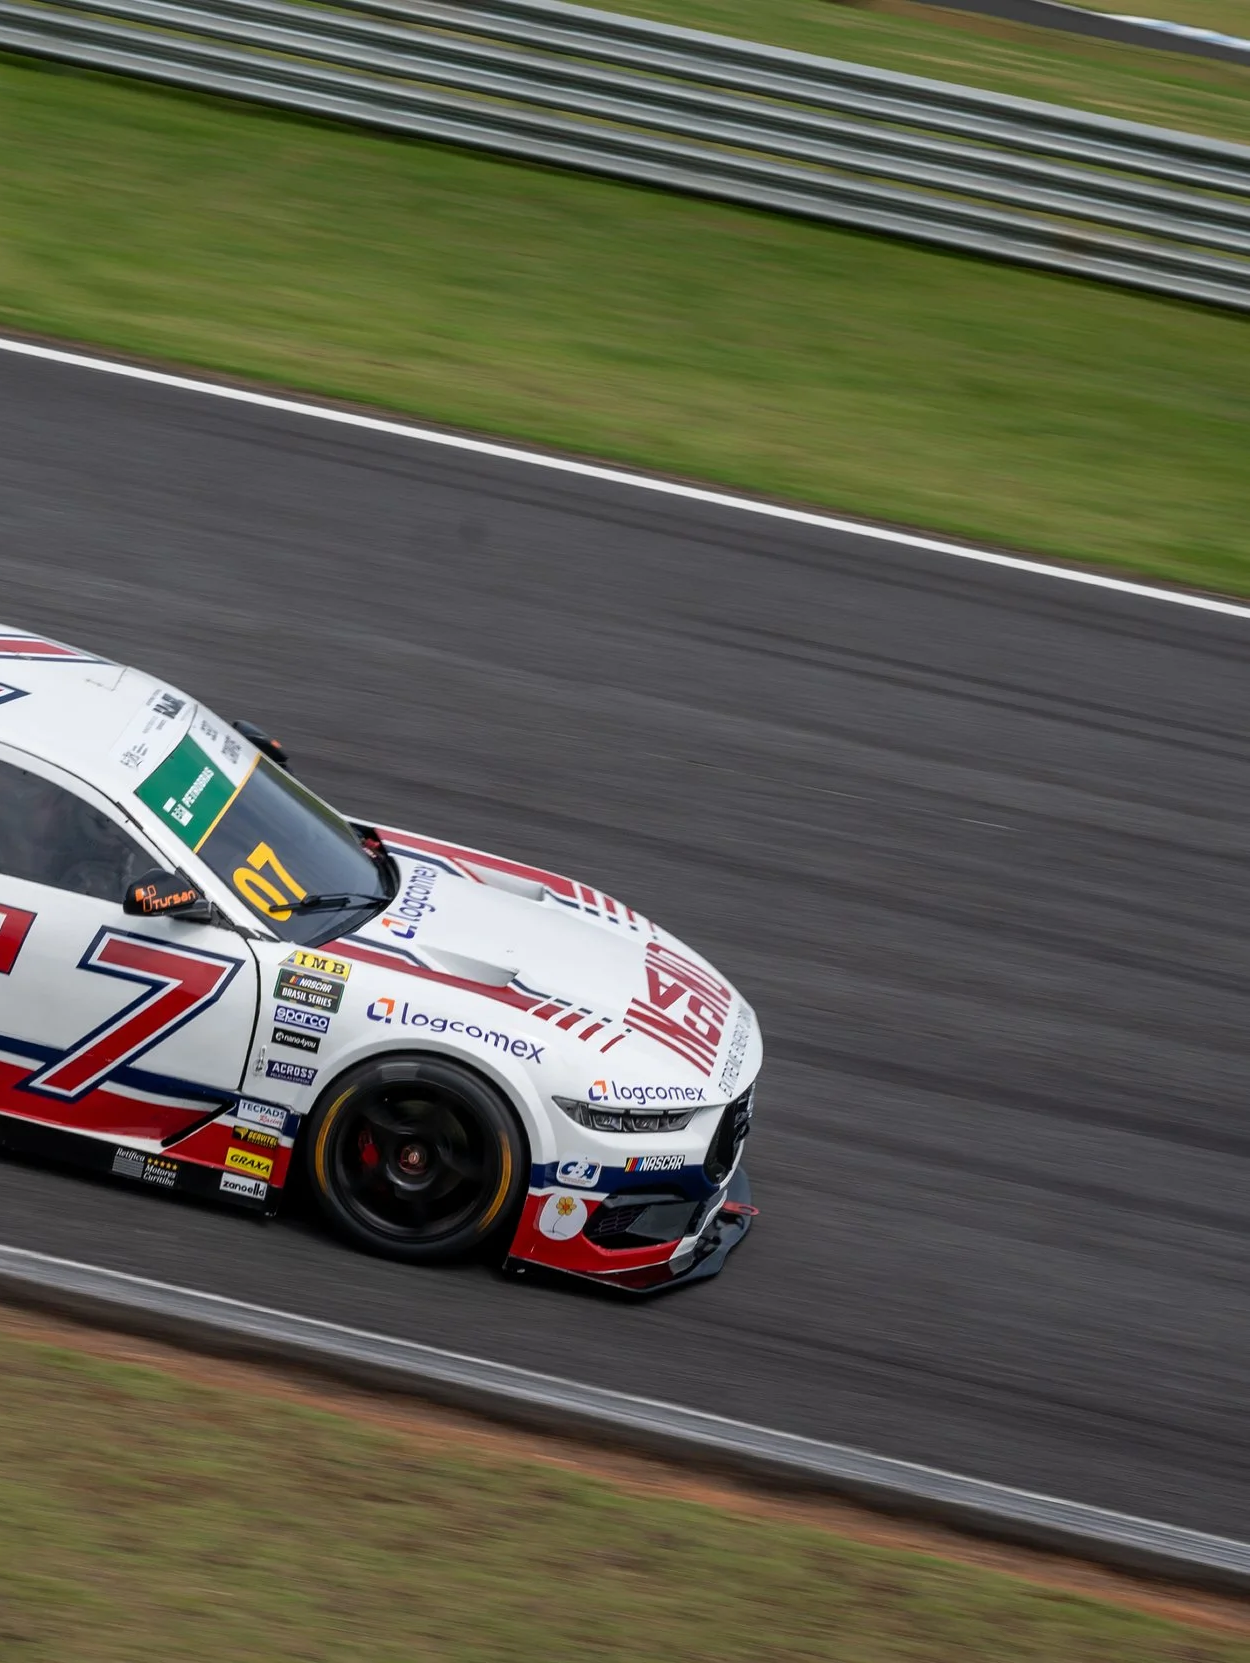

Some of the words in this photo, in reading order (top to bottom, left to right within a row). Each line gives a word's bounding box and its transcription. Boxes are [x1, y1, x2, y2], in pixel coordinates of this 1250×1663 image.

[233, 841, 308, 922] 07
[299, 977, 333, 994] NASCAR
[281, 986, 307, 1001] BRASIL
[307, 993, 333, 1008] SERIES
[76, 925, 247, 1104] 7
[276, 1006, 329, 1030] sparco
[284, 1034, 317, 1049] nano4you
[401, 1002, 546, 1065] logcomex
[271, 1062, 316, 1080] ACROSS
[611, 1080, 707, 1105] logcomex
[242, 1101, 285, 1120] TECPADS
[144, 1163, 177, 1180] Motores
[230, 1153, 270, 1174] GRAXA
[560, 1159, 598, 1181] CBA
[639, 1154, 686, 1173] NASCAR
[142, 1171, 175, 1188] Curitiba
